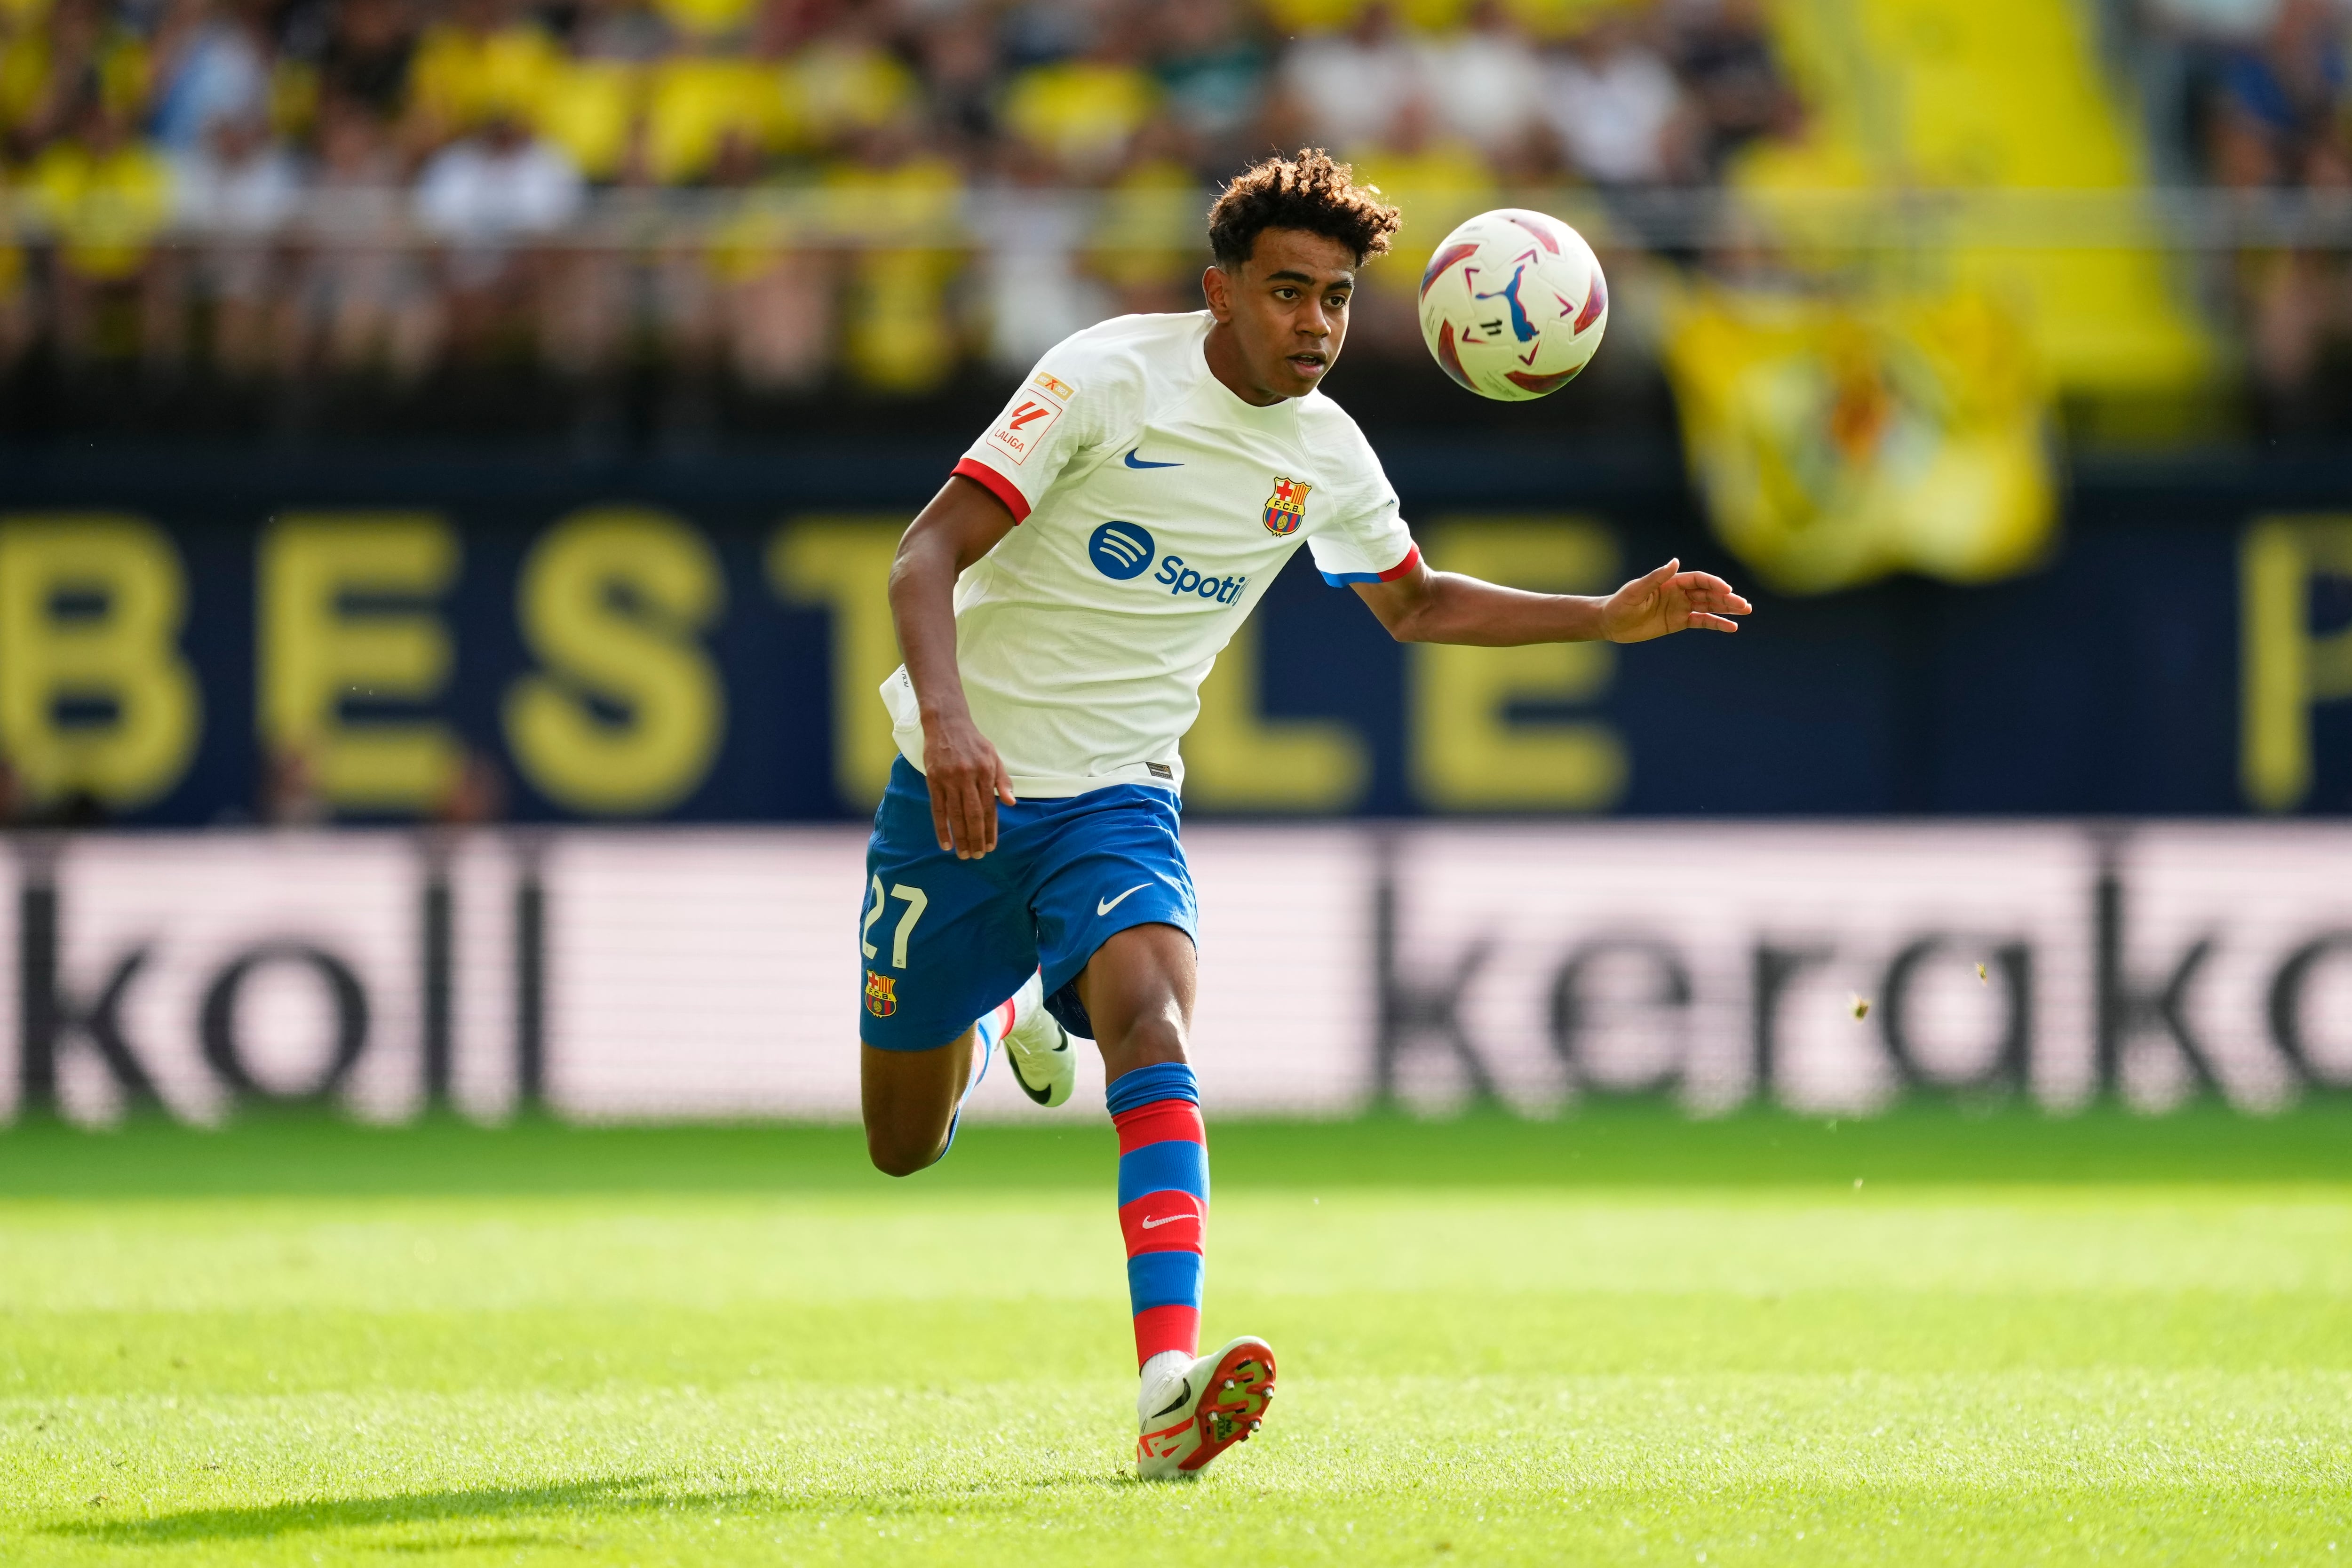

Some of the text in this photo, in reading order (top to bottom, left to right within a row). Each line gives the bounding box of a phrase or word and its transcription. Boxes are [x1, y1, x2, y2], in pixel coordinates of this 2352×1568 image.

[1055, 385, 1068, 396] 2023
[994, 429, 1024, 453] LALIGA
[1274, 501, 1300, 513] F.C.B.
[1154, 555, 1252, 607] Spoti
[862, 874, 928, 969] 27
[869, 988, 891, 1000] F.C.B.
